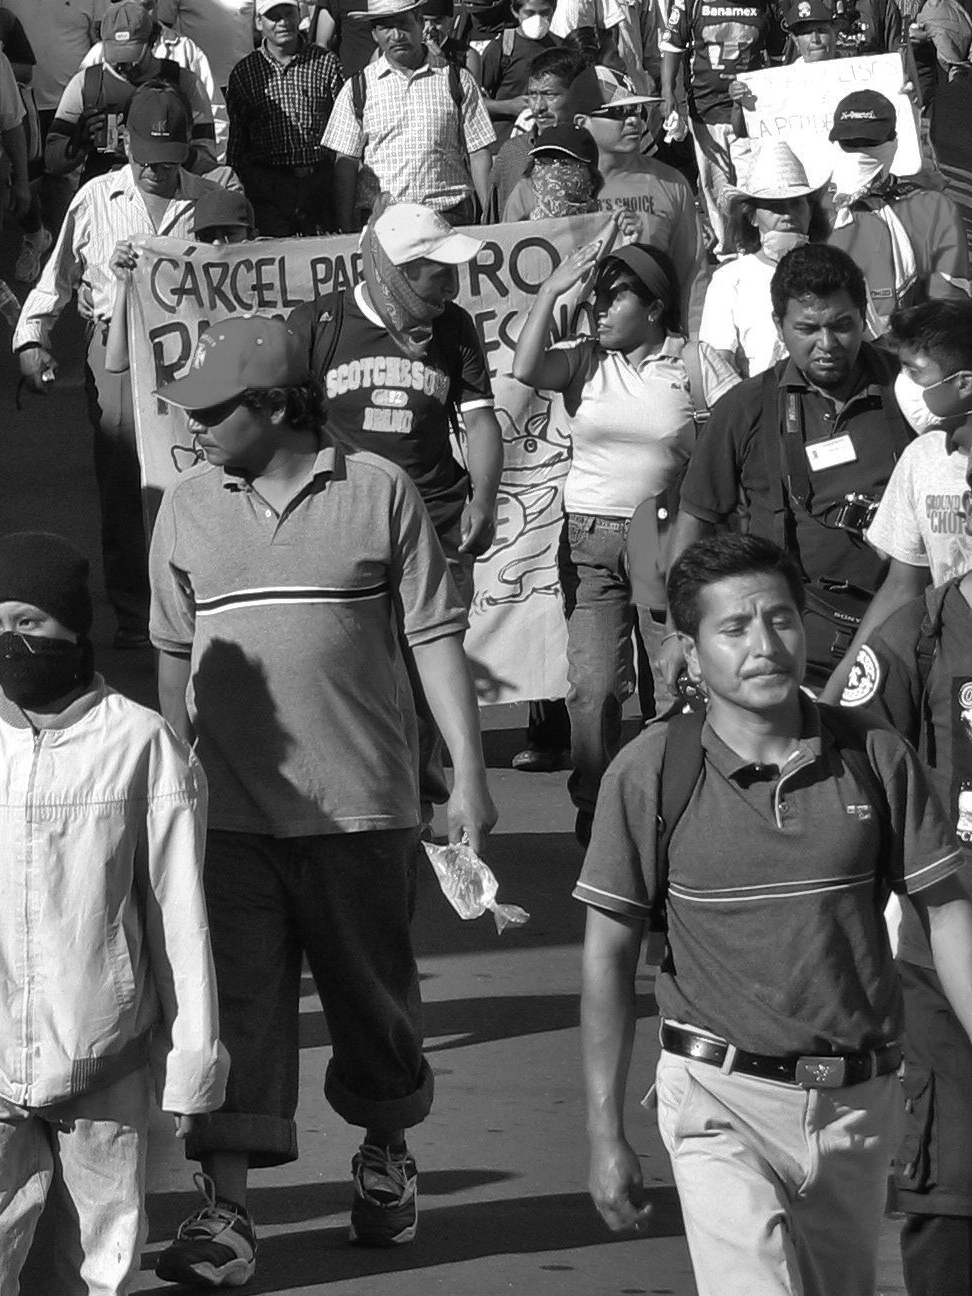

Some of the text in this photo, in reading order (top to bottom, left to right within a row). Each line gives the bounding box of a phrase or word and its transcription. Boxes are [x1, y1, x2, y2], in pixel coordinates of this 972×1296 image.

[701, 5, 758, 17] Banamex
[615, 195, 656, 215] CHOICE
[150, 245, 304, 313] CÁRCEL
